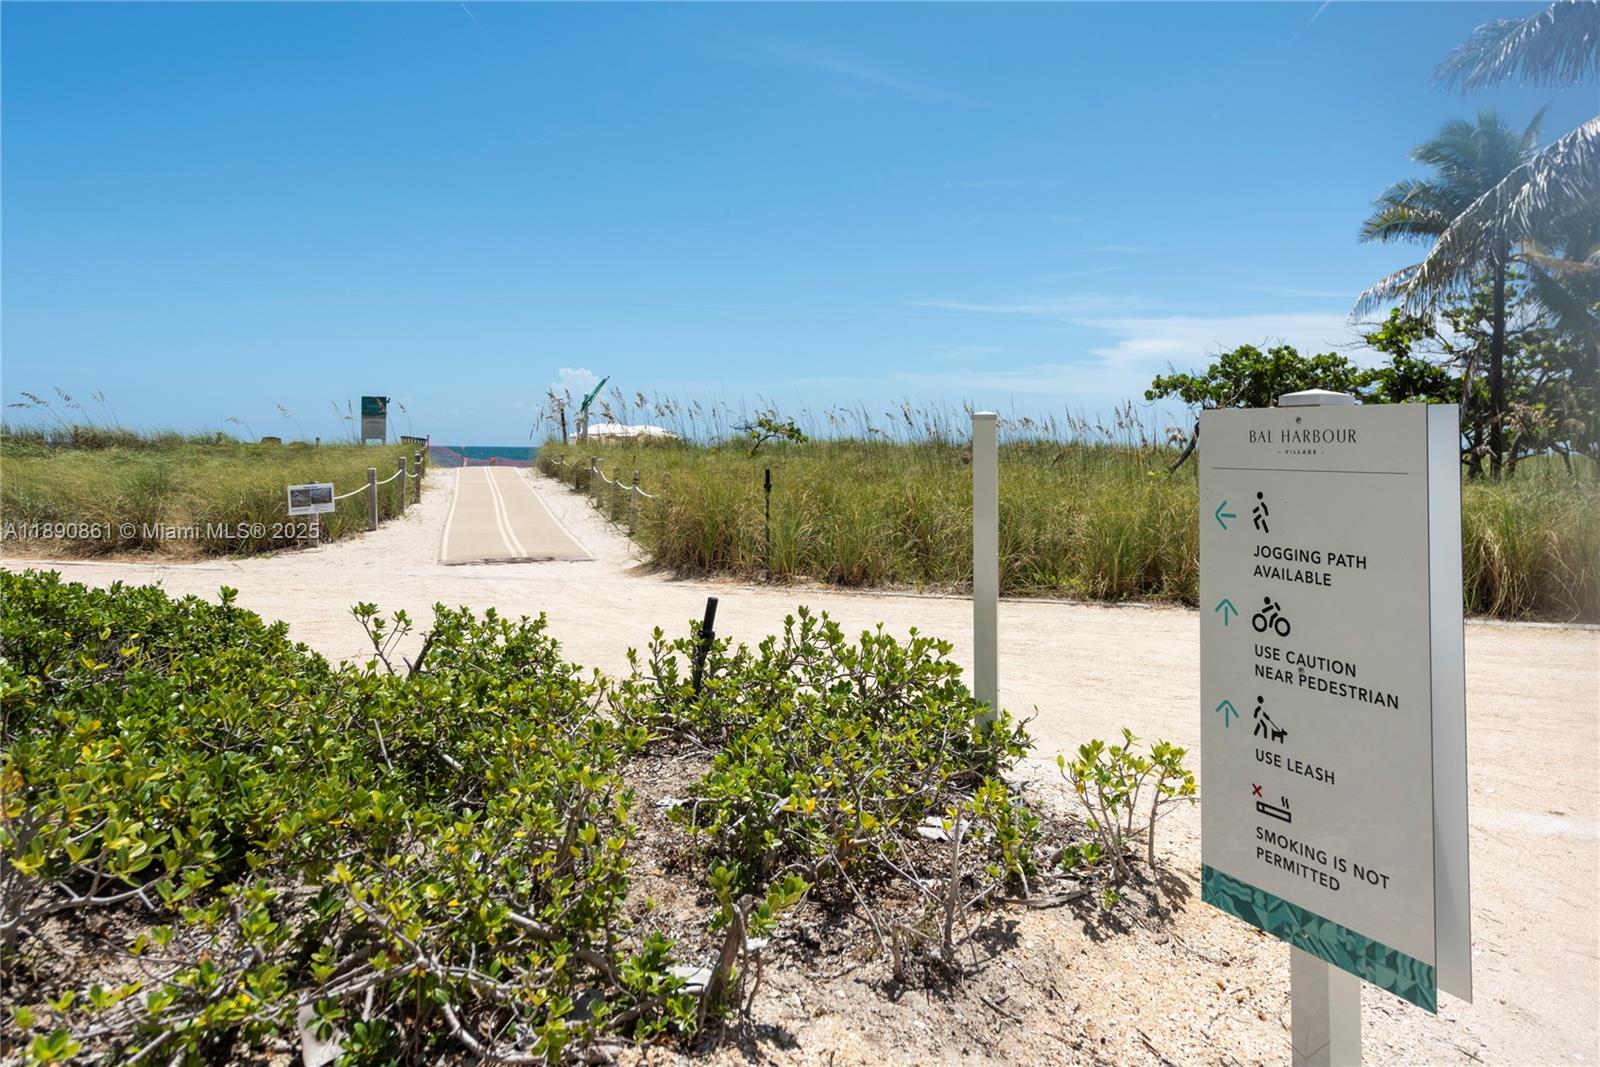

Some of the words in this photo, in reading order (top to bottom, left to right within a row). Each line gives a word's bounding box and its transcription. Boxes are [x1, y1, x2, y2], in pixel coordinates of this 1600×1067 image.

[1249, 429, 1273, 444] BAL
[1281, 428, 1357, 444] HARBOUR
[1253, 545, 1321, 564] JOGGING
[1328, 552, 1367, 570] PATH
[1253, 565, 1332, 587] AVAILABLE
[1255, 644, 1281, 661] USE
[1286, 651, 1356, 677] CAUTION
[1255, 664, 1293, 685] NEAR
[1299, 674, 1399, 709] PEDESTRIAN
[1255, 748, 1281, 769] USE
[1287, 758, 1335, 785] LEASH
[1256, 826, 1327, 865] SMOKING
[1333, 855, 1347, 873] IS
[1353, 863, 1390, 890] NOT
[1256, 848, 1340, 892] PERMITTED
